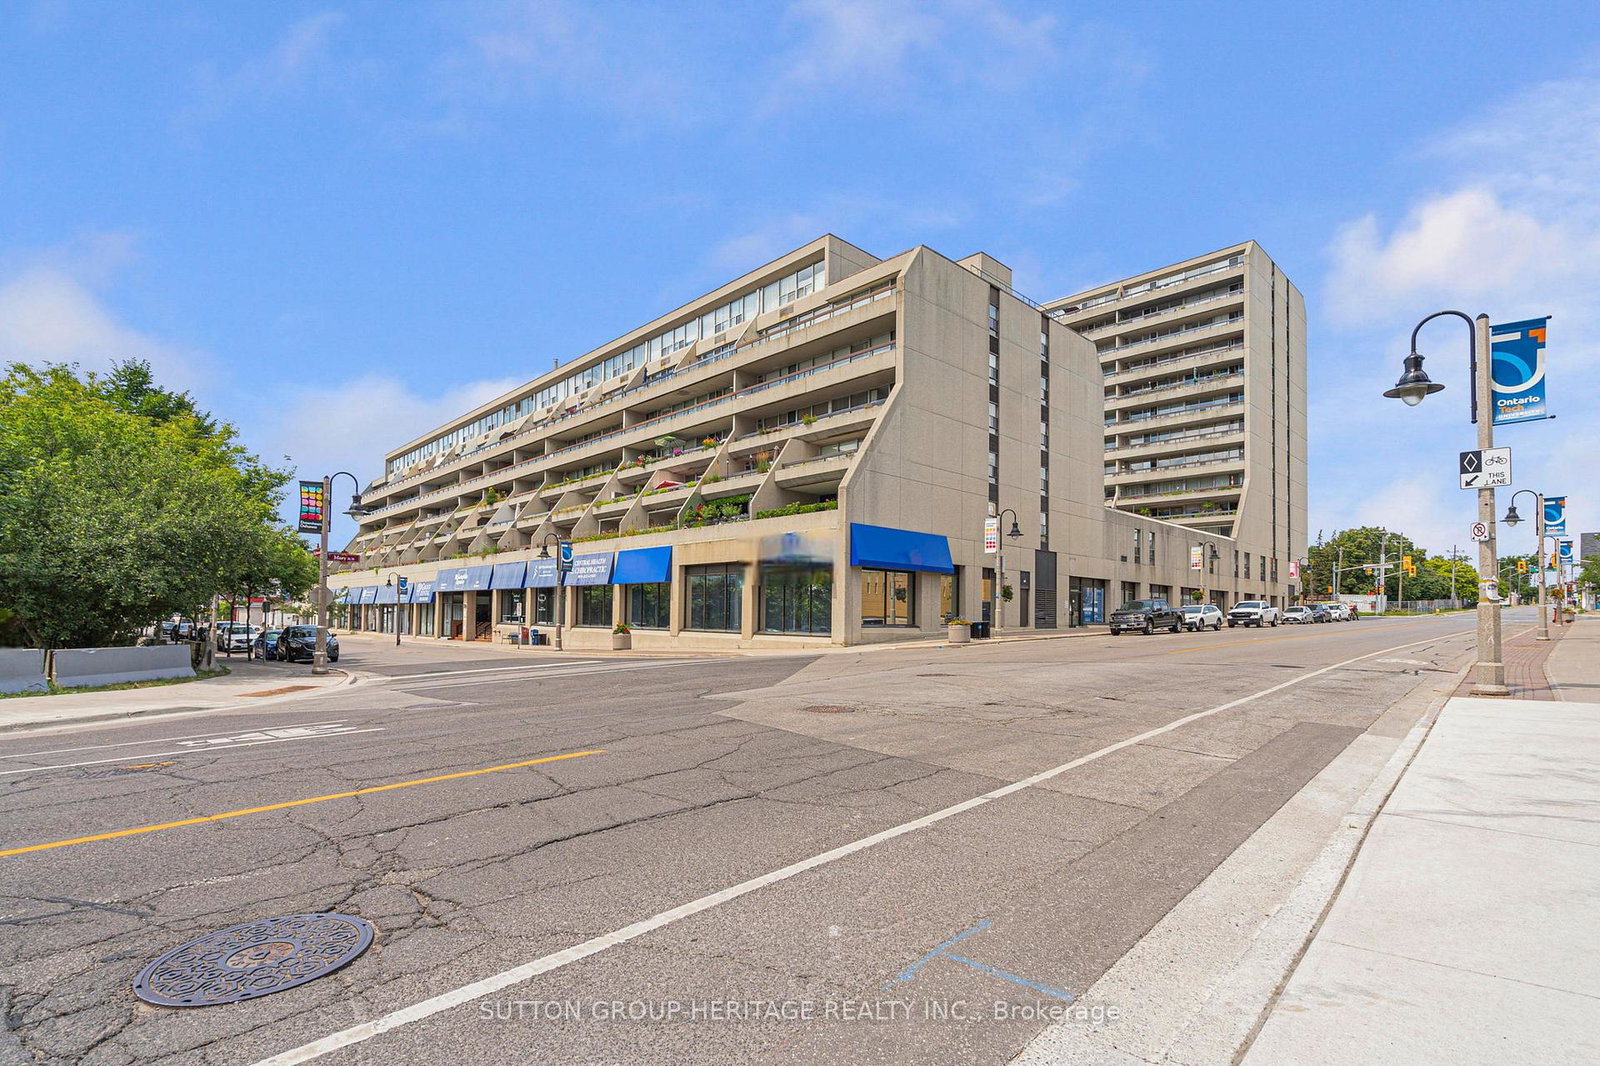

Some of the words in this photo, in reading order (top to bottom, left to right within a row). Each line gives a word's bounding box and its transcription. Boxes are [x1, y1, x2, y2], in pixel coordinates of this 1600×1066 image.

[1497, 395, 1540, 406] Ontario
[1499, 405, 1524, 414] Tech
[1485, 478, 1507, 486] LANE
